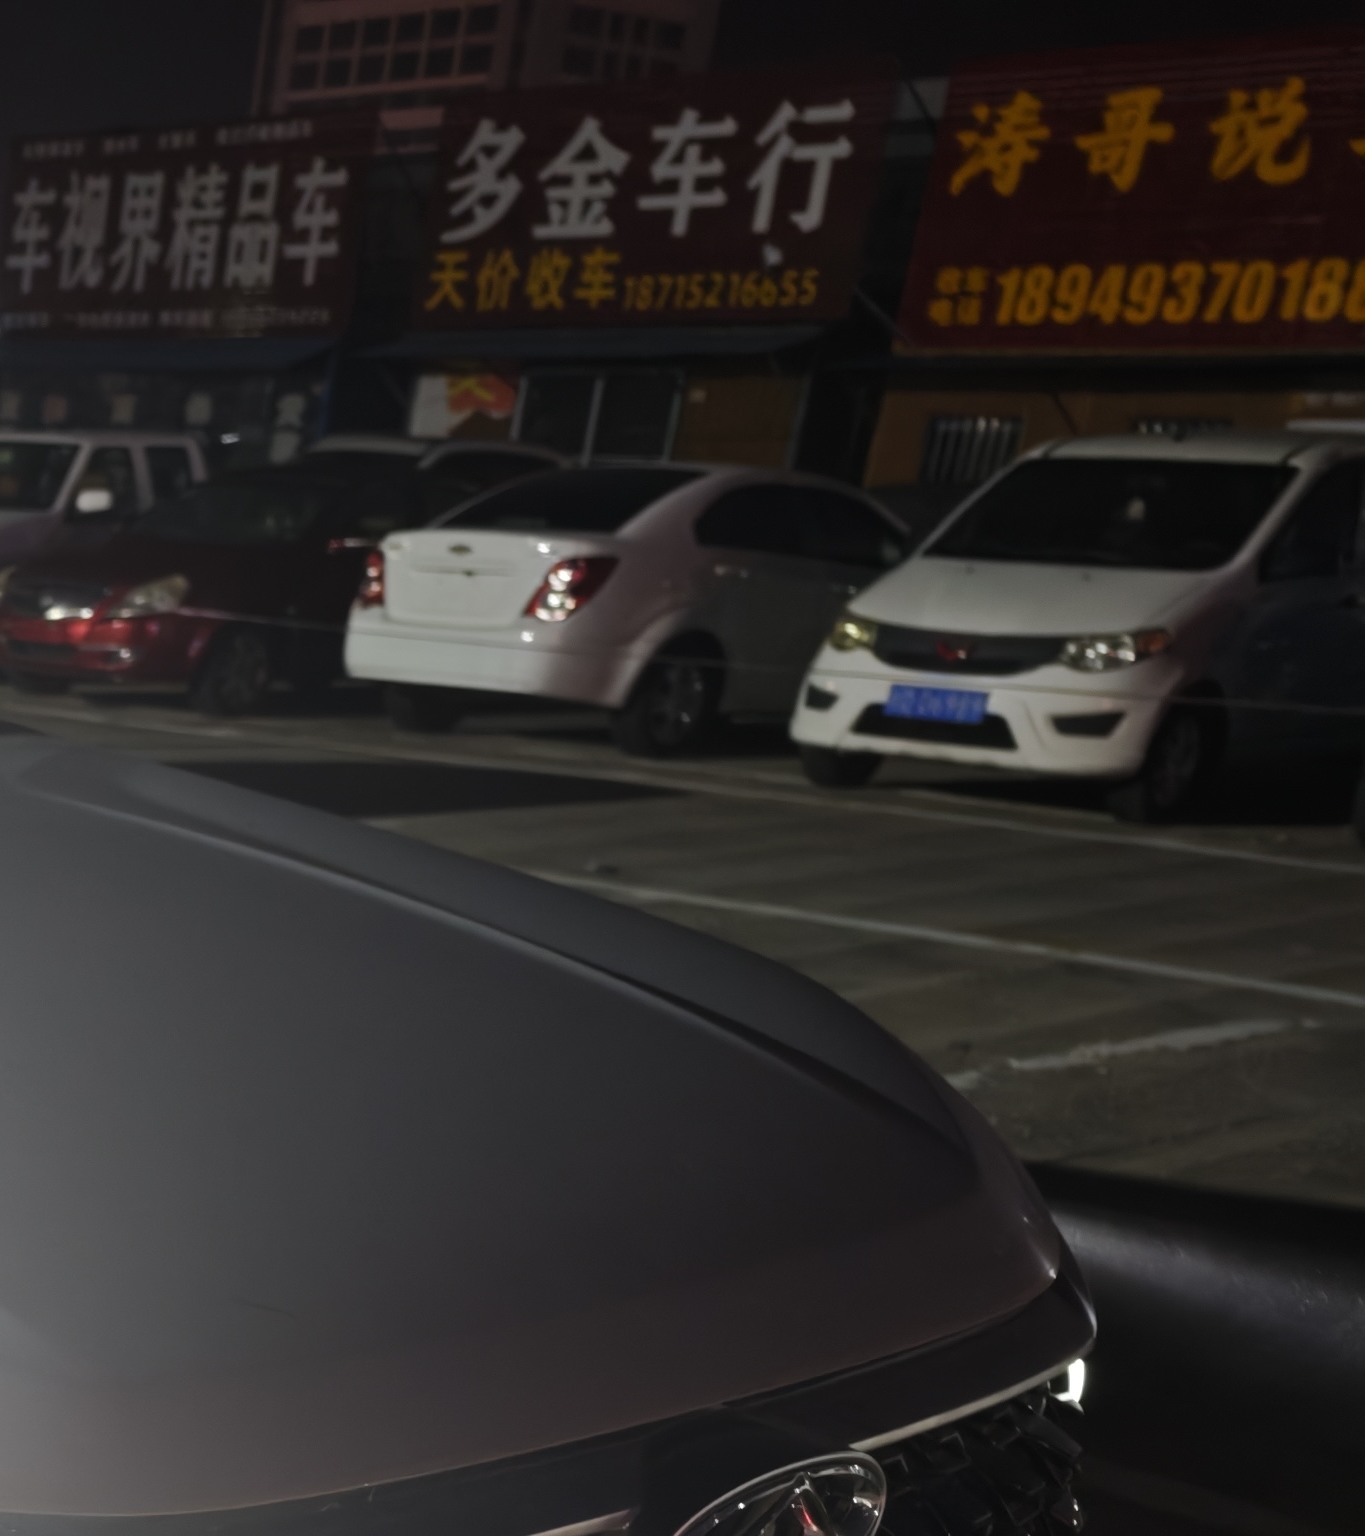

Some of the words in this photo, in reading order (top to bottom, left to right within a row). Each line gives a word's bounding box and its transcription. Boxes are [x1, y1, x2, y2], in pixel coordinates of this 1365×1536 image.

[440, 99, 855, 243] 多金车行
[950, 77, 1365, 196] 涛哥说
[5, 156, 348, 294] 车视界精品车
[426, 247, 621, 311] 天价收车
[625, 268, 819, 311] 18715216655
